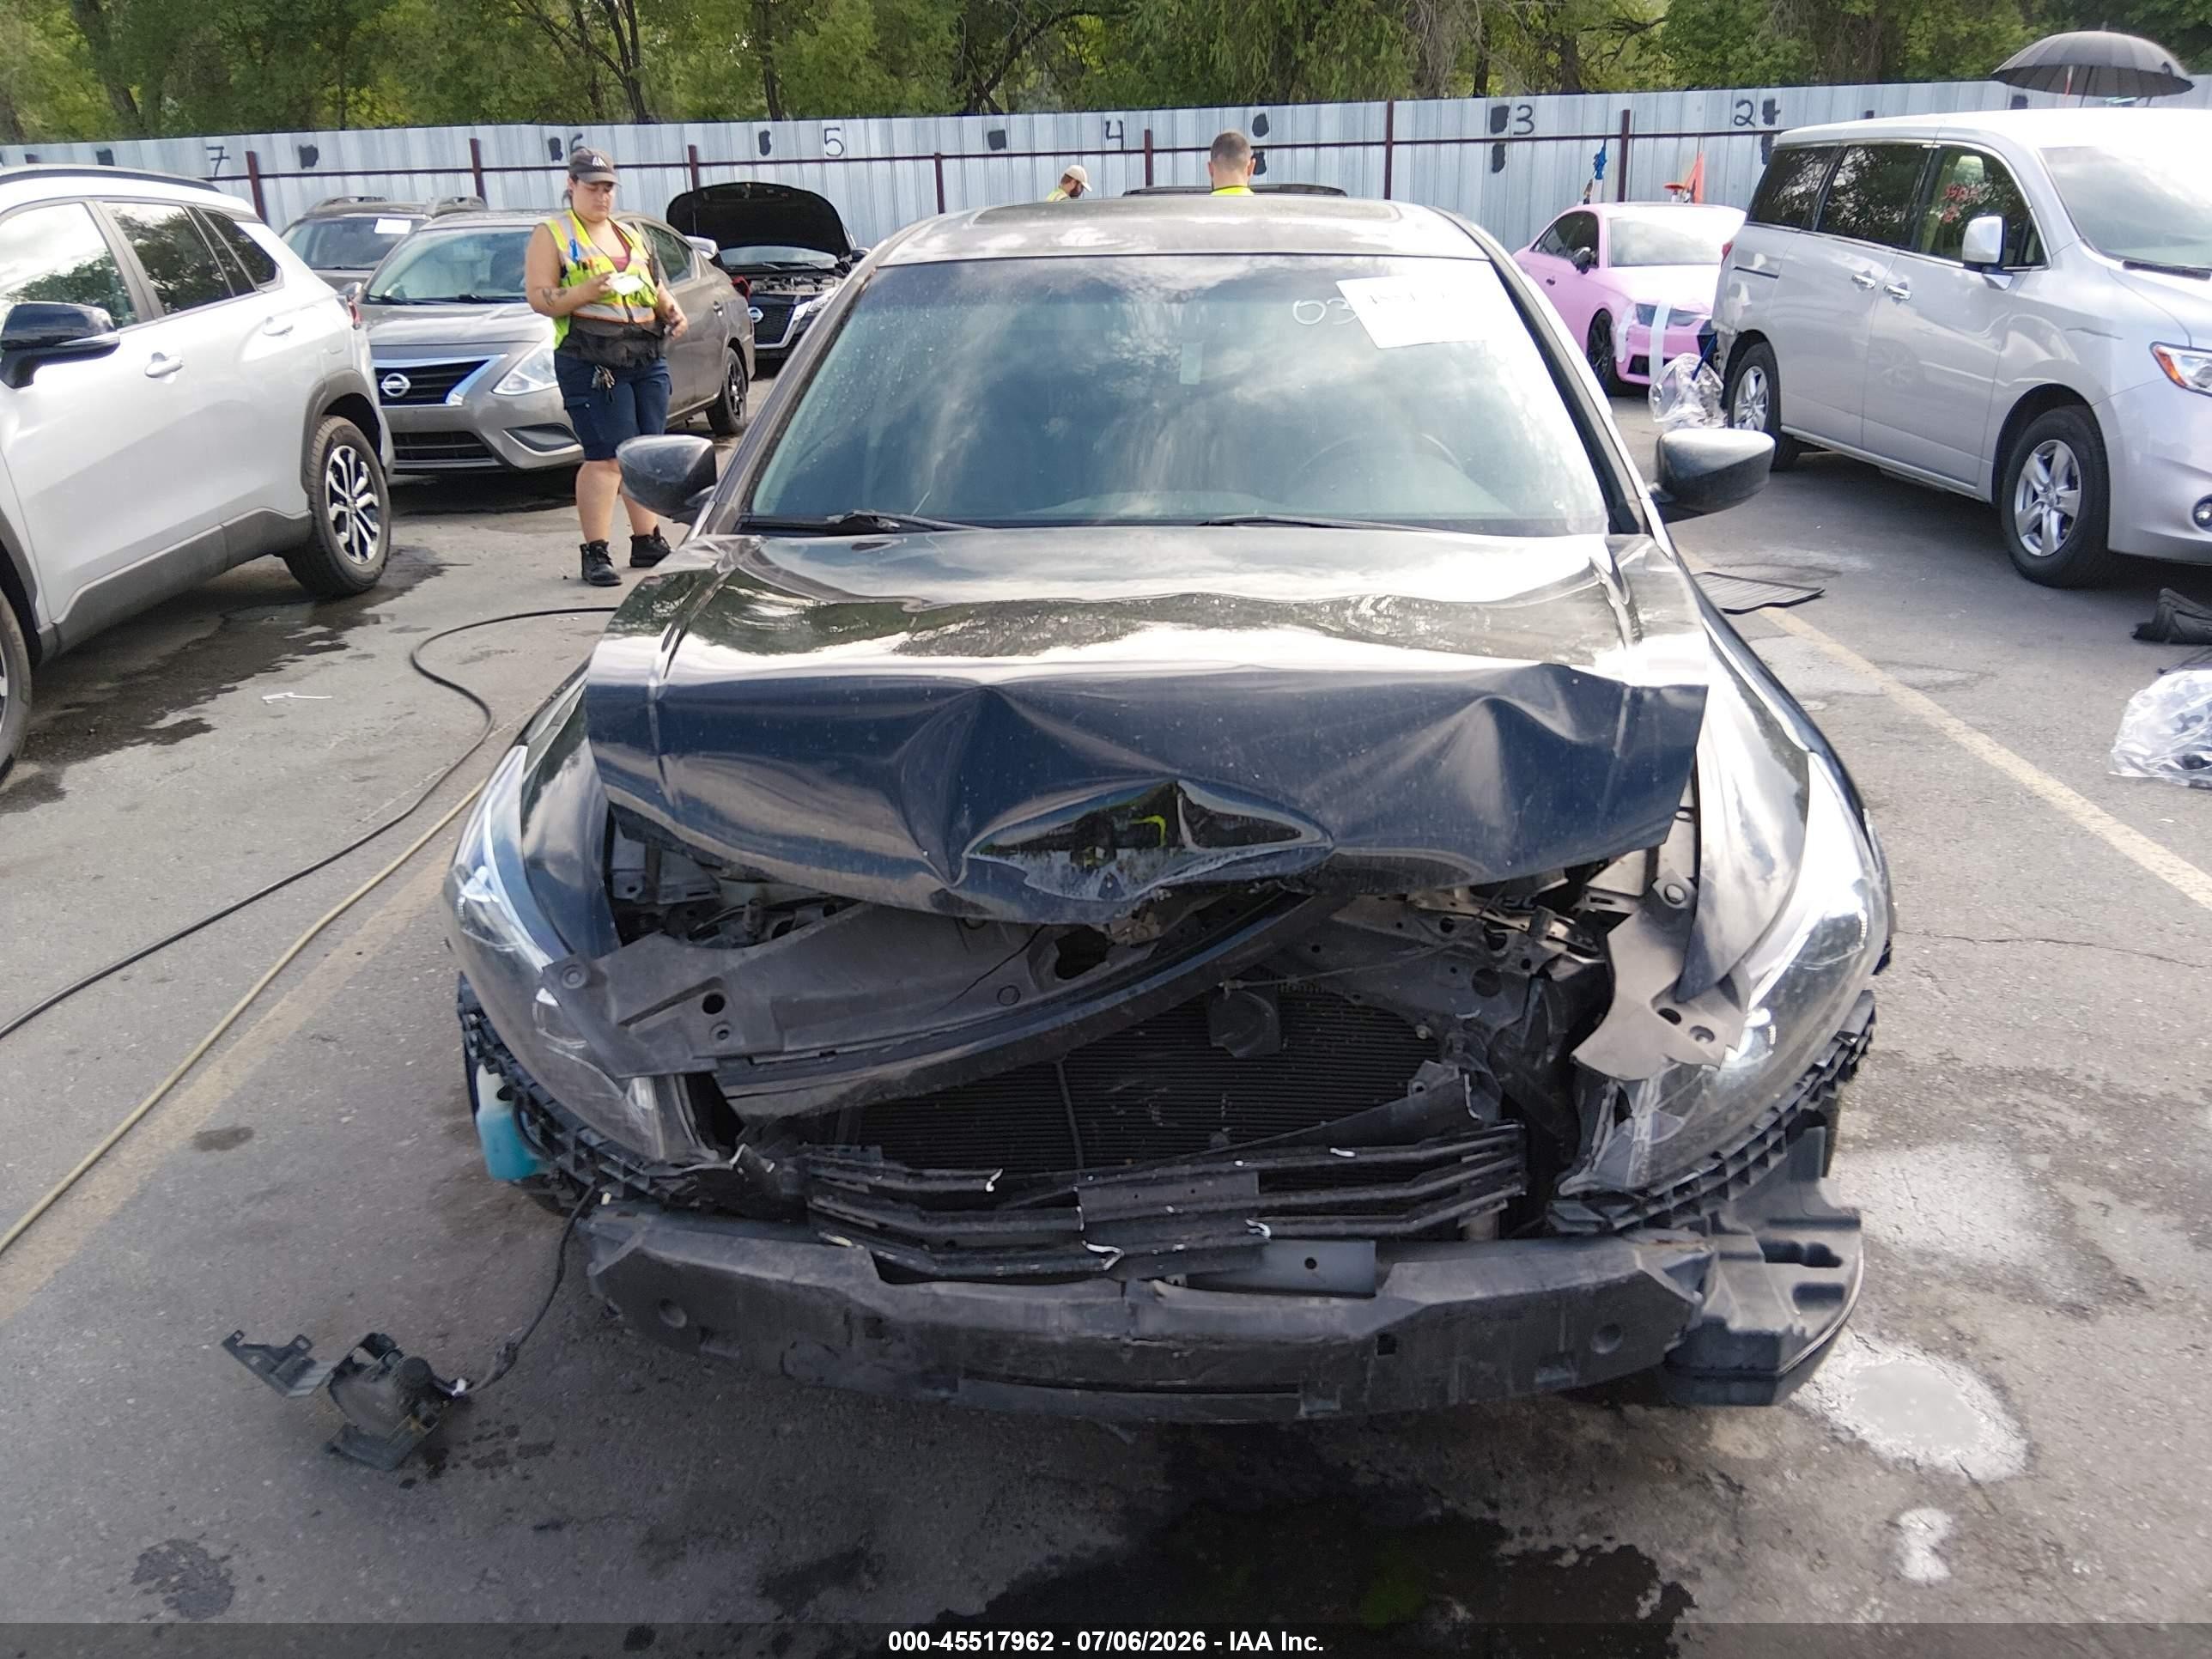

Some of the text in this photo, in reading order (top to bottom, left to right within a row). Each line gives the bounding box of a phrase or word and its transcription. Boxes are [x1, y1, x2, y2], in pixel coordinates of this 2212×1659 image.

[1512, 104, 1535, 136] 3
[1734, 99, 1756, 128] 2
[823, 127, 845, 157] 5
[1105, 120, 1124, 151] 4
[206, 146, 230, 177] 7
